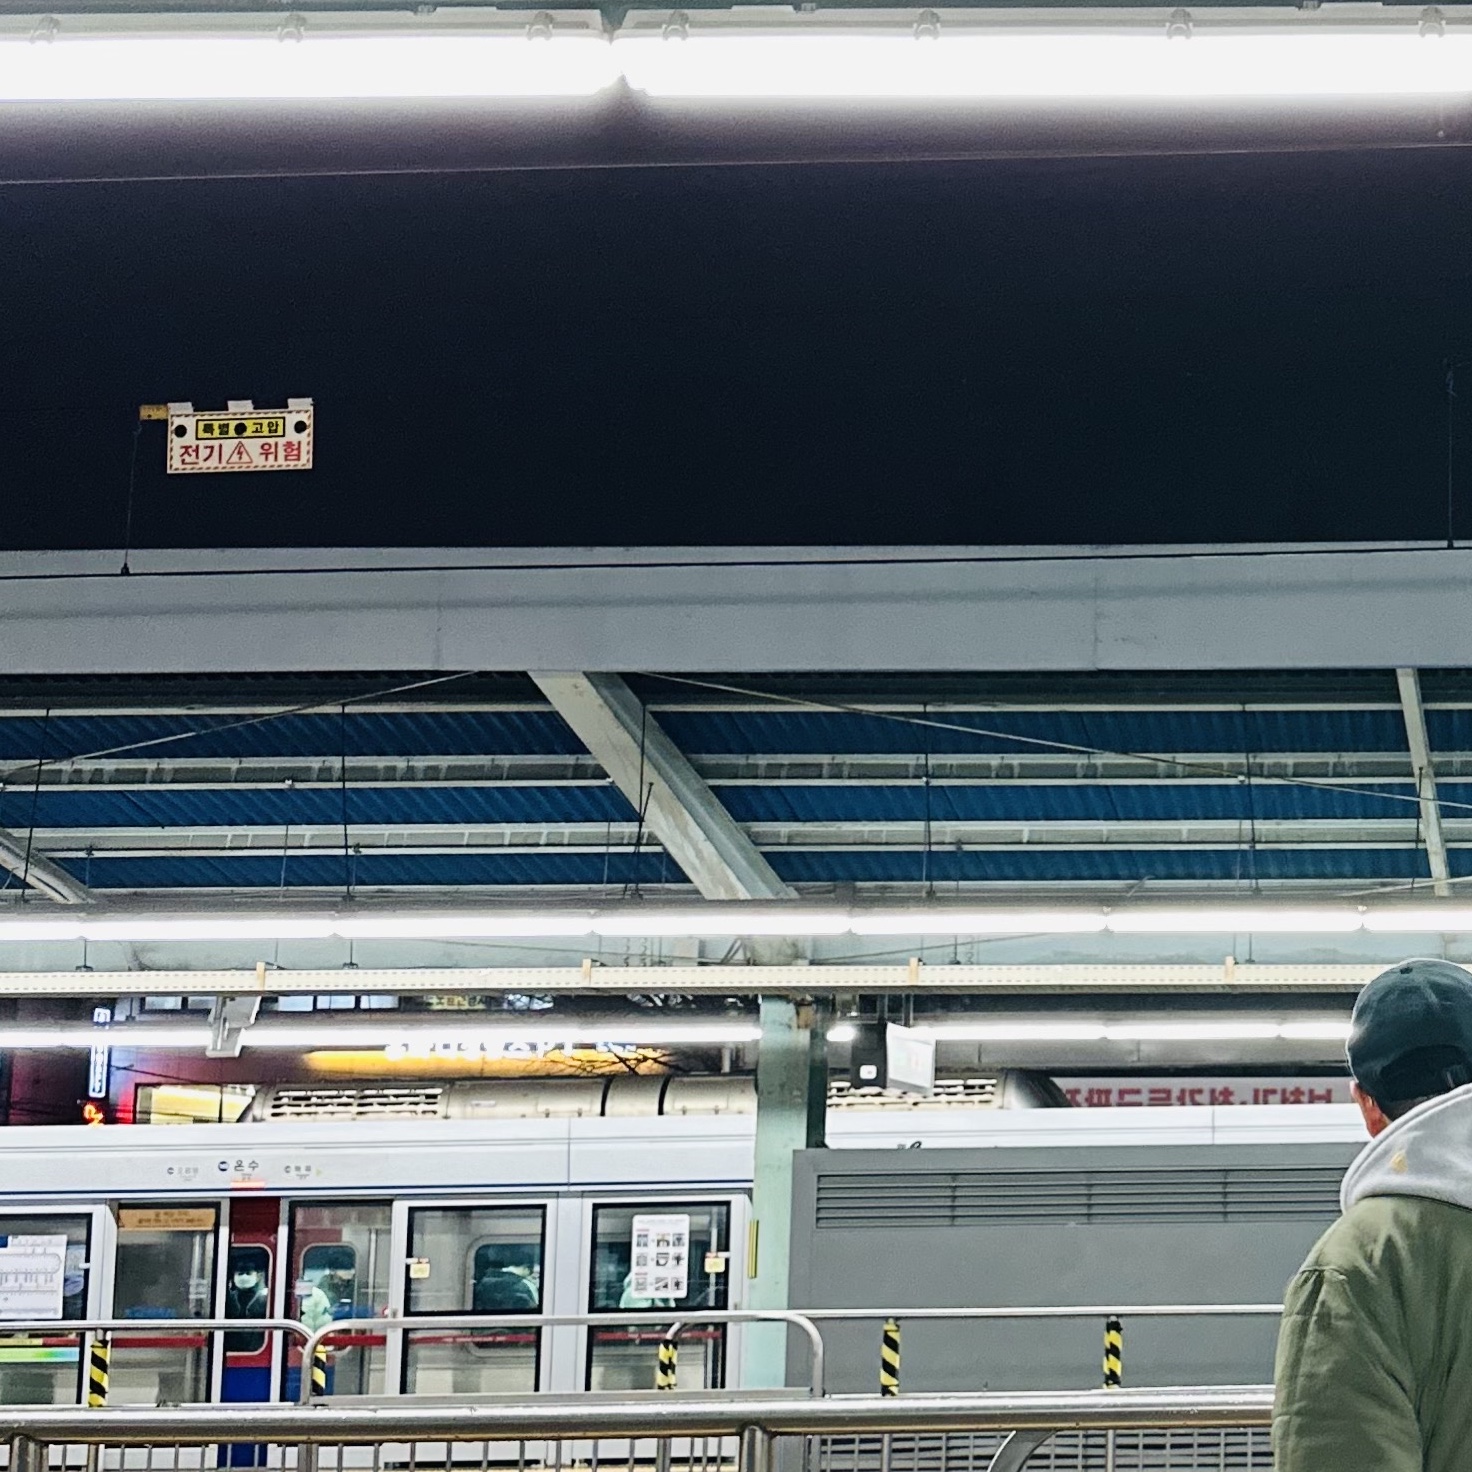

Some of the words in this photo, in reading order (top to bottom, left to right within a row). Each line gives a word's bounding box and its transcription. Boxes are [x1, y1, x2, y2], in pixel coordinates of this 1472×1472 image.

[202, 423, 230, 436] 특별
[252, 420, 279, 433] 고압
[179, 443, 223, 465] 전기
[259, 440, 302, 462] 위험
[233, 1159, 259, 1172] 온수
